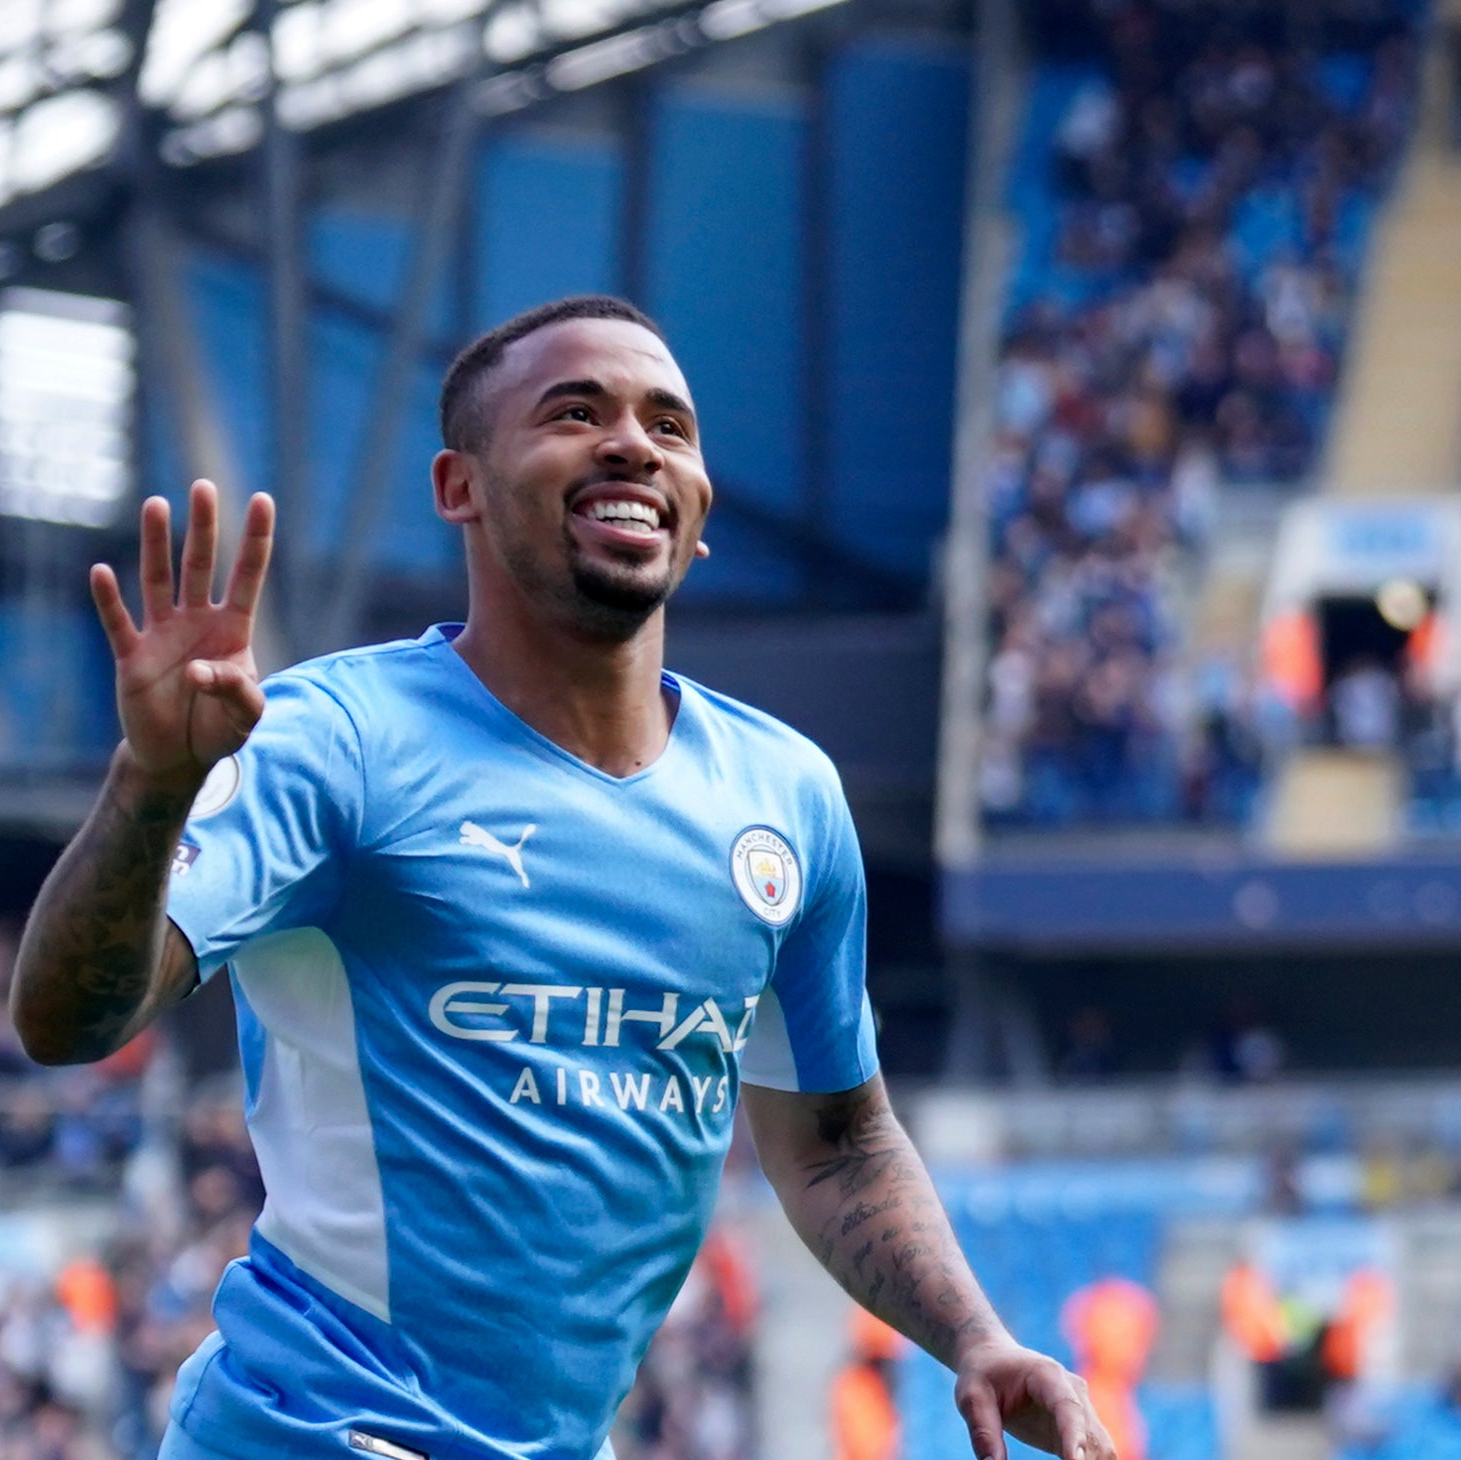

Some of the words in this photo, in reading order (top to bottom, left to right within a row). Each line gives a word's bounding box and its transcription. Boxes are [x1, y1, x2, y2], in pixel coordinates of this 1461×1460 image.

[737, 832, 793, 865] MANCHESTER
[763, 907, 781, 917] CITY
[509, 1066, 729, 1114] AIRWAYS
